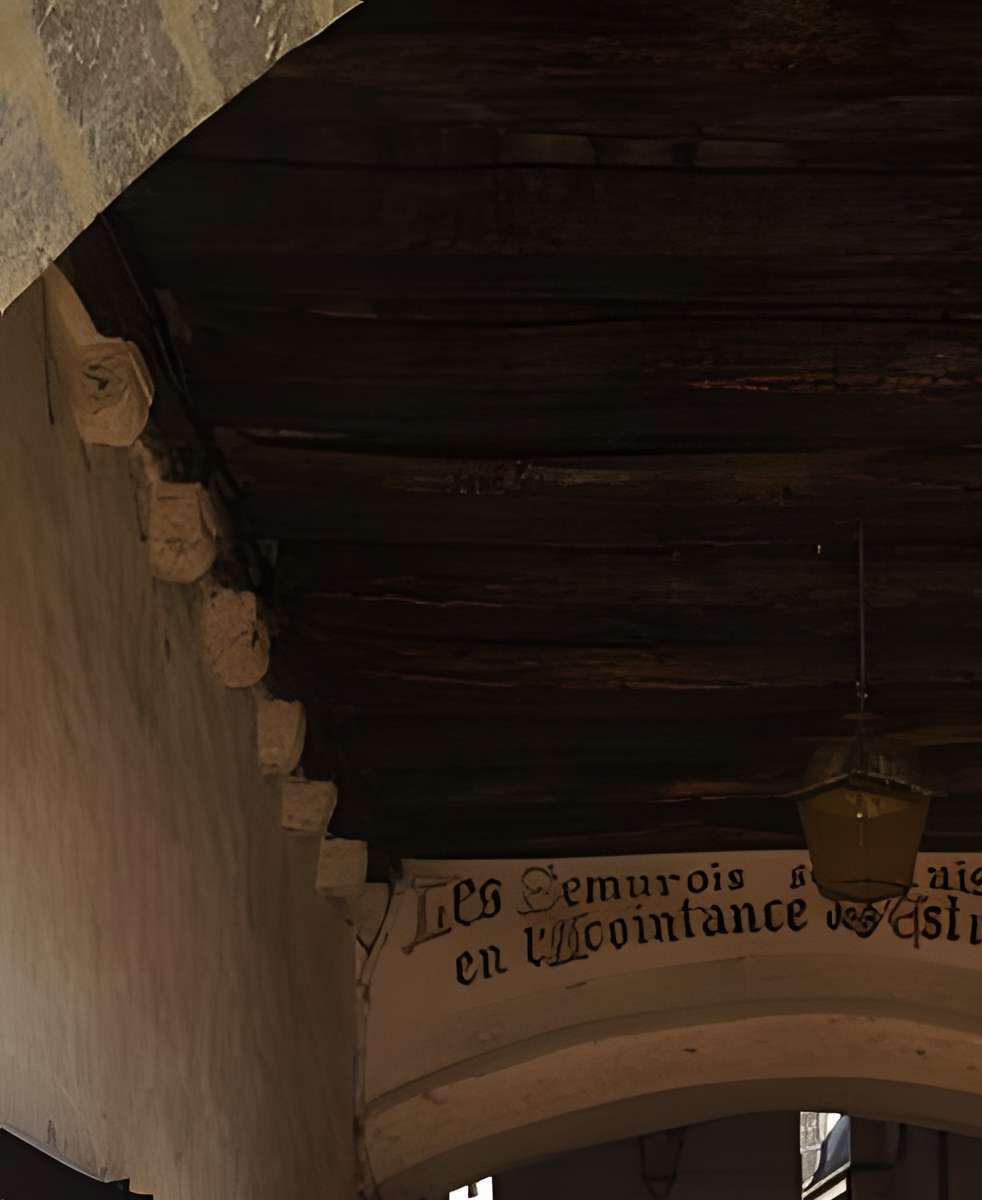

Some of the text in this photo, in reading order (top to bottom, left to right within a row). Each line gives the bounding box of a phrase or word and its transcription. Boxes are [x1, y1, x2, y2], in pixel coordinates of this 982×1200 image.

[402, 875, 502, 955] Les
[789, 864, 807, 889] s
[455, 944, 508, 986] en
